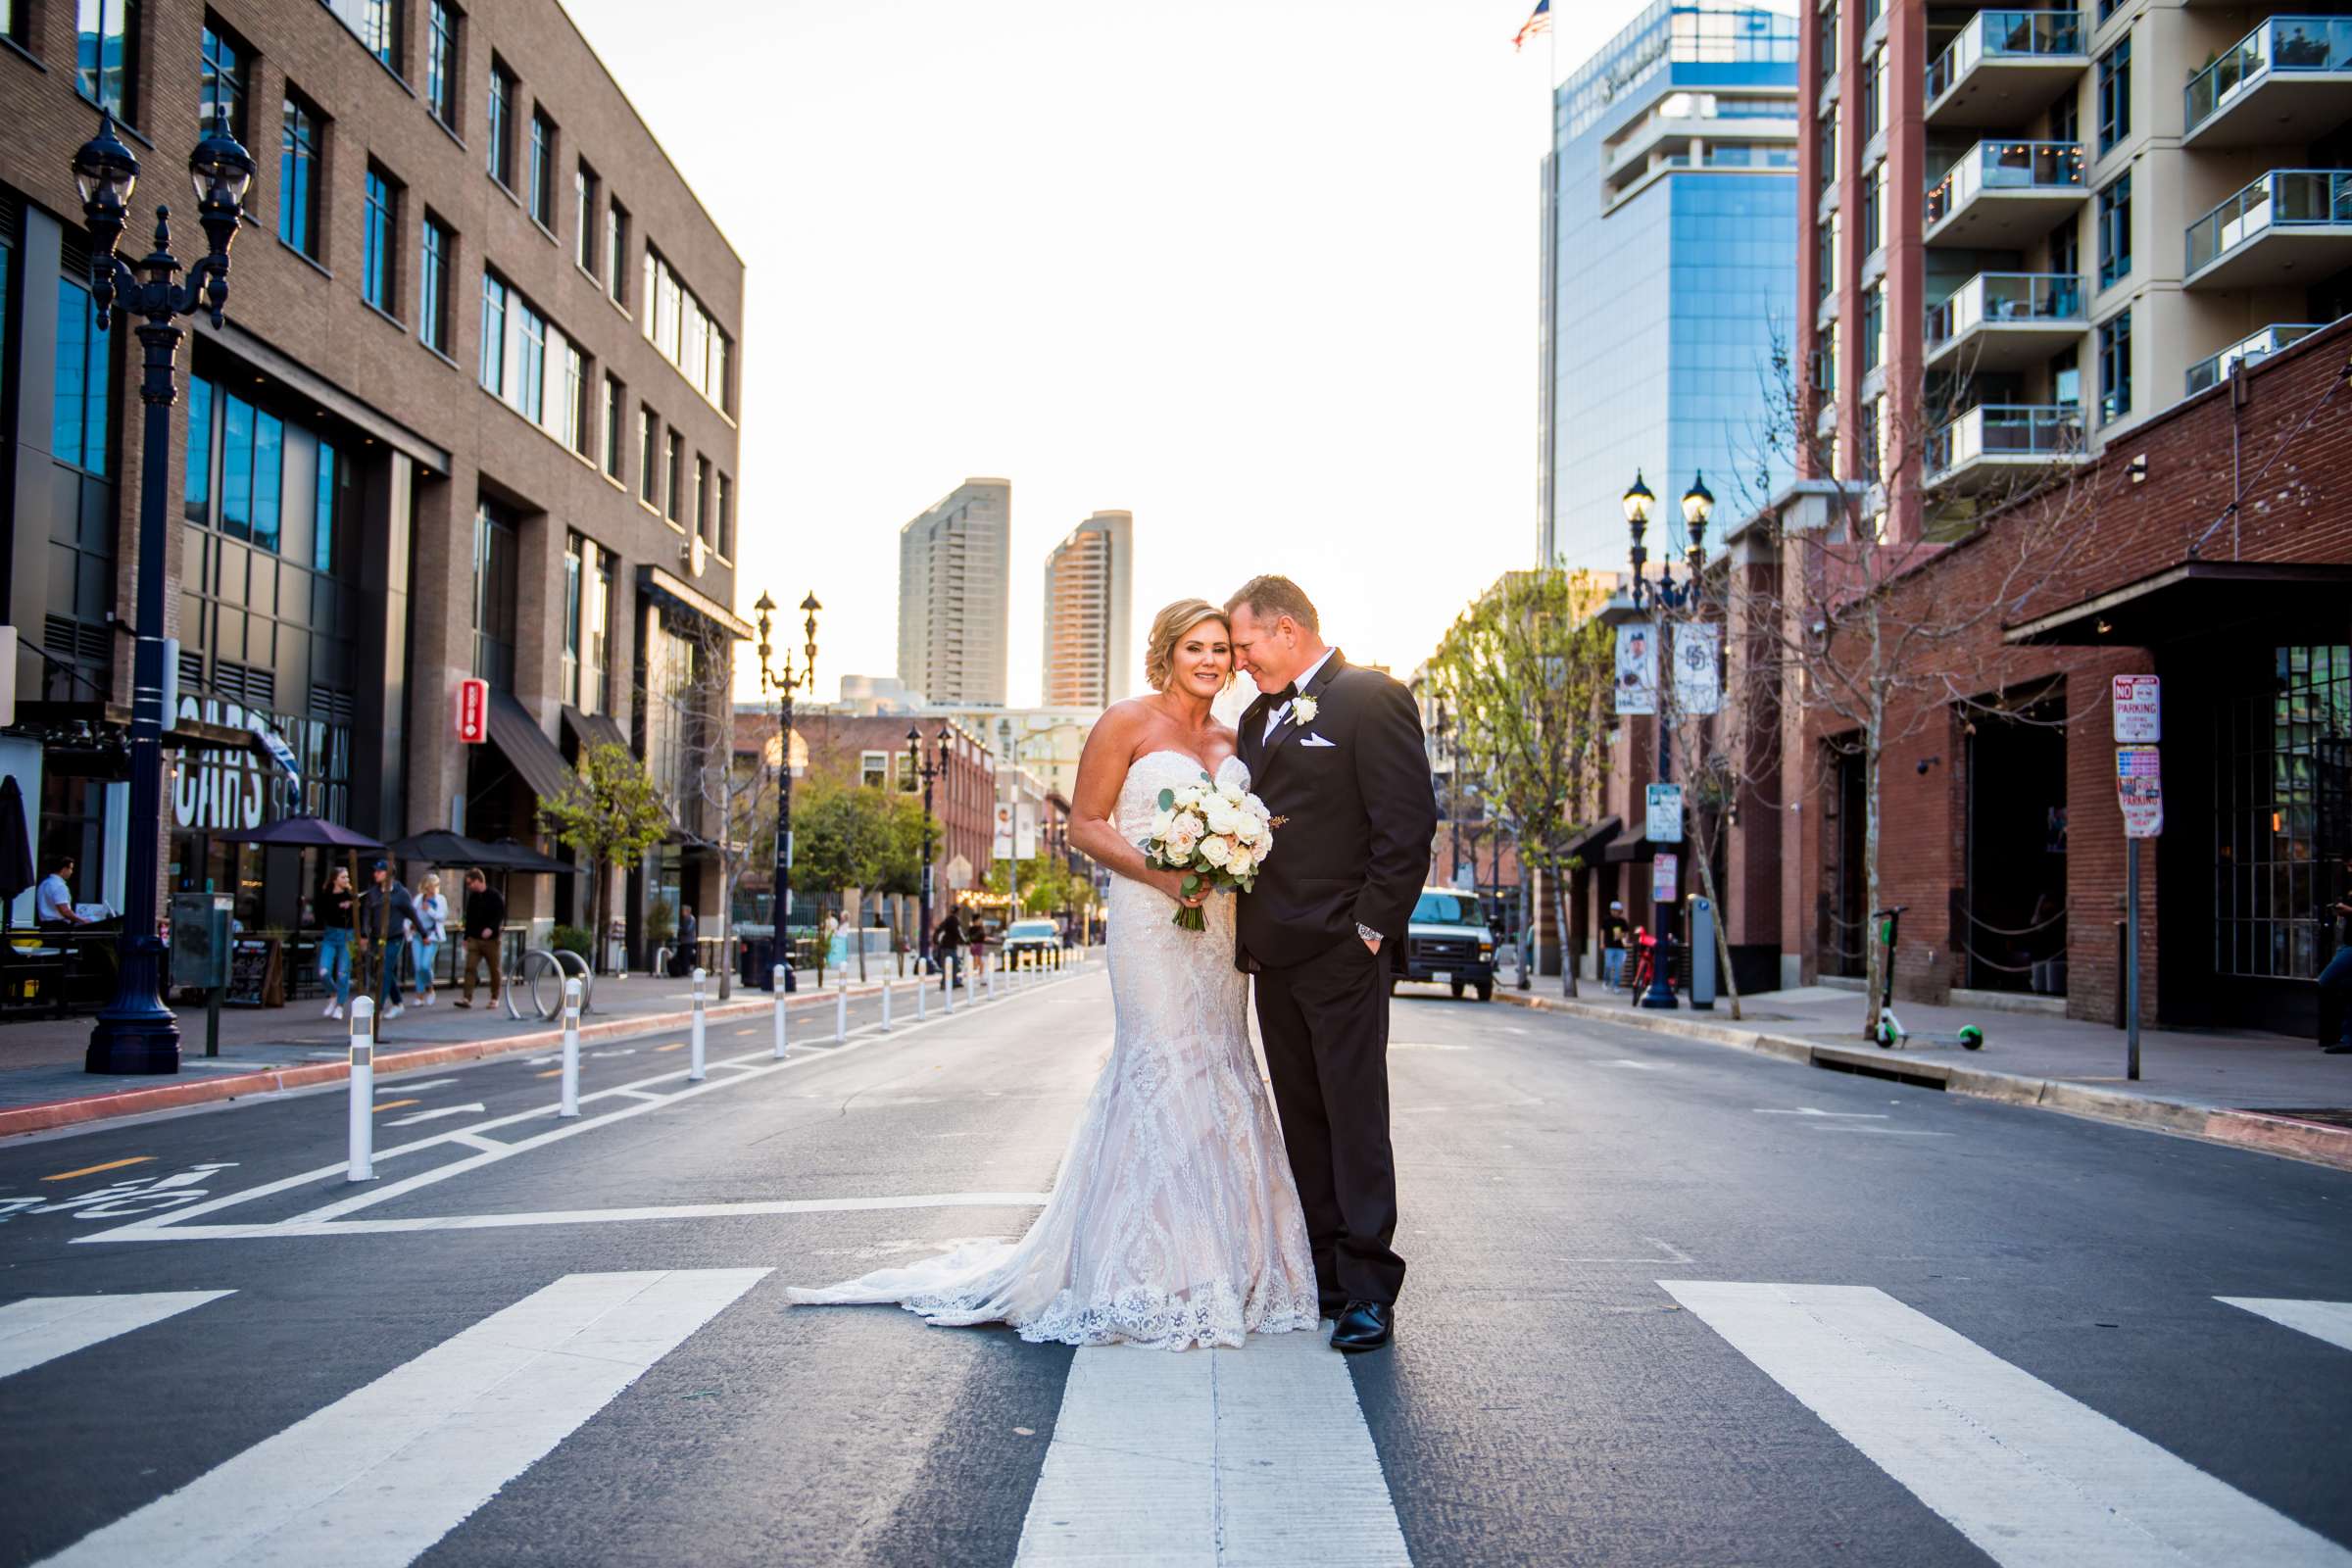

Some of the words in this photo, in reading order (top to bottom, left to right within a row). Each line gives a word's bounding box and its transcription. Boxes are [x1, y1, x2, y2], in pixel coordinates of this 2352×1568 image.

[2117, 684, 2132, 699] NO
[2117, 703, 2157, 713] PARKING
[172, 695, 264, 831] CARS
[2123, 793, 2158, 807] PARKING
